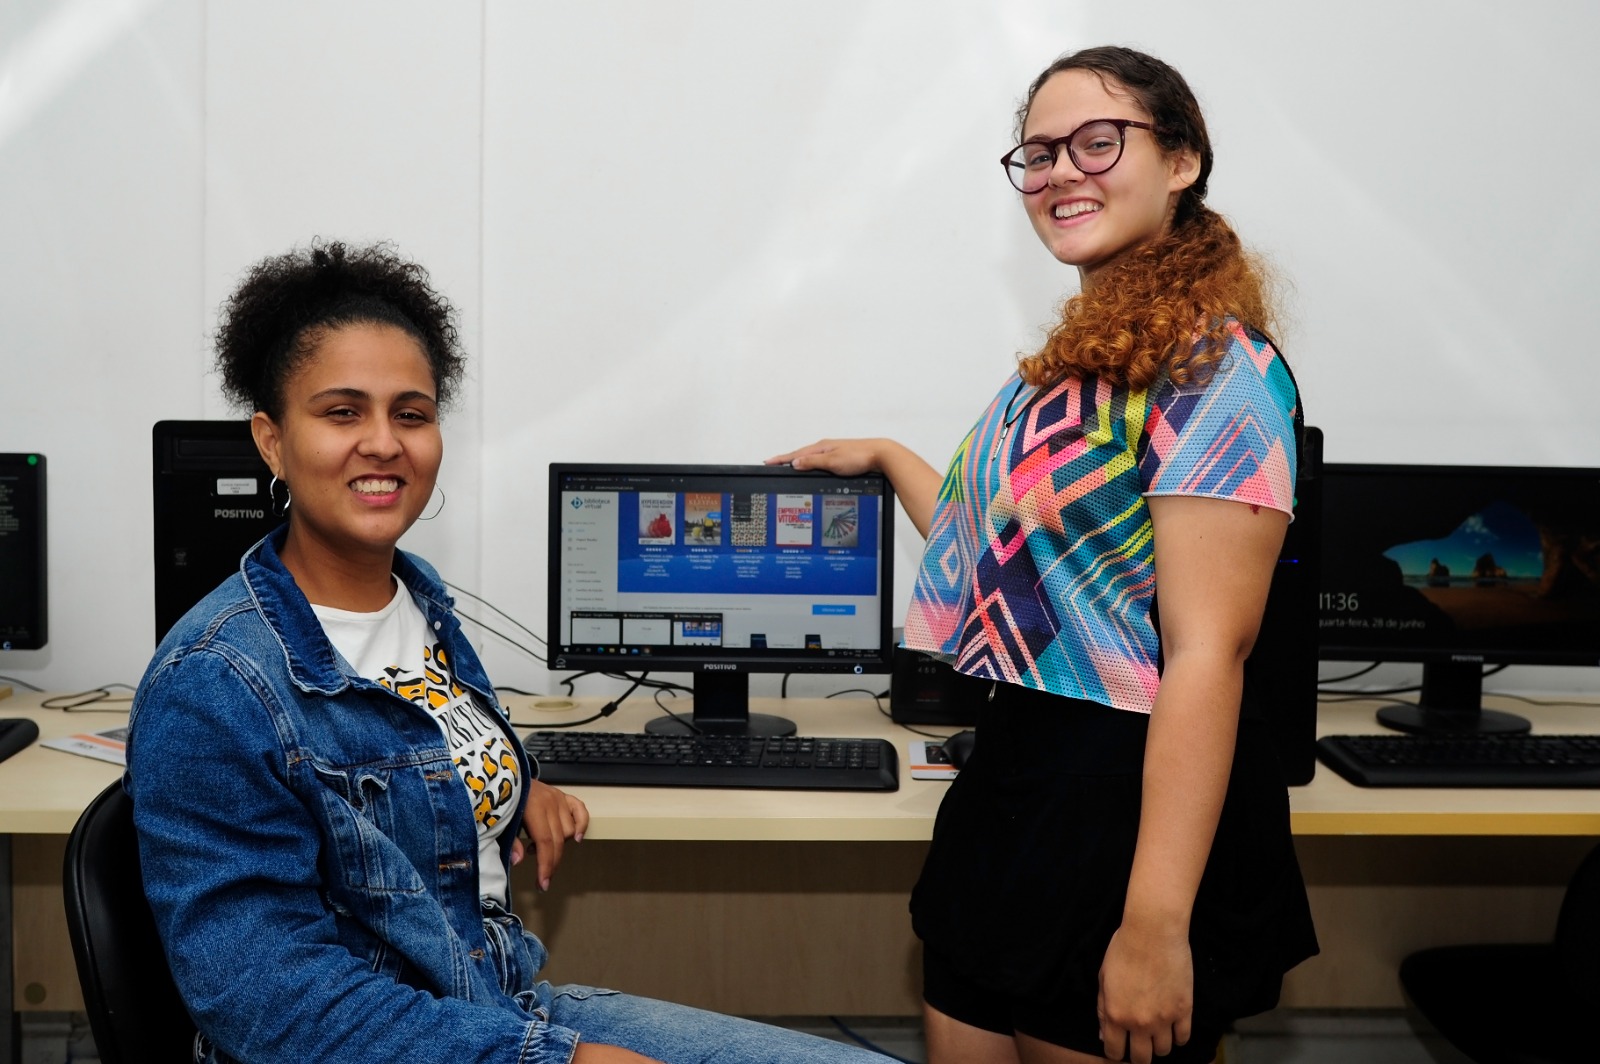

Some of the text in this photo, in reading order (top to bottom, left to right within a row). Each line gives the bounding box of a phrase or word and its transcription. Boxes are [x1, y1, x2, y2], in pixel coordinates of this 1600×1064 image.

[214, 509, 264, 519] POSITIVO
[1372, 618, 1384, 627] 28
[1385, 618, 1398, 628] de
[1399, 618, 1426, 630] junho
